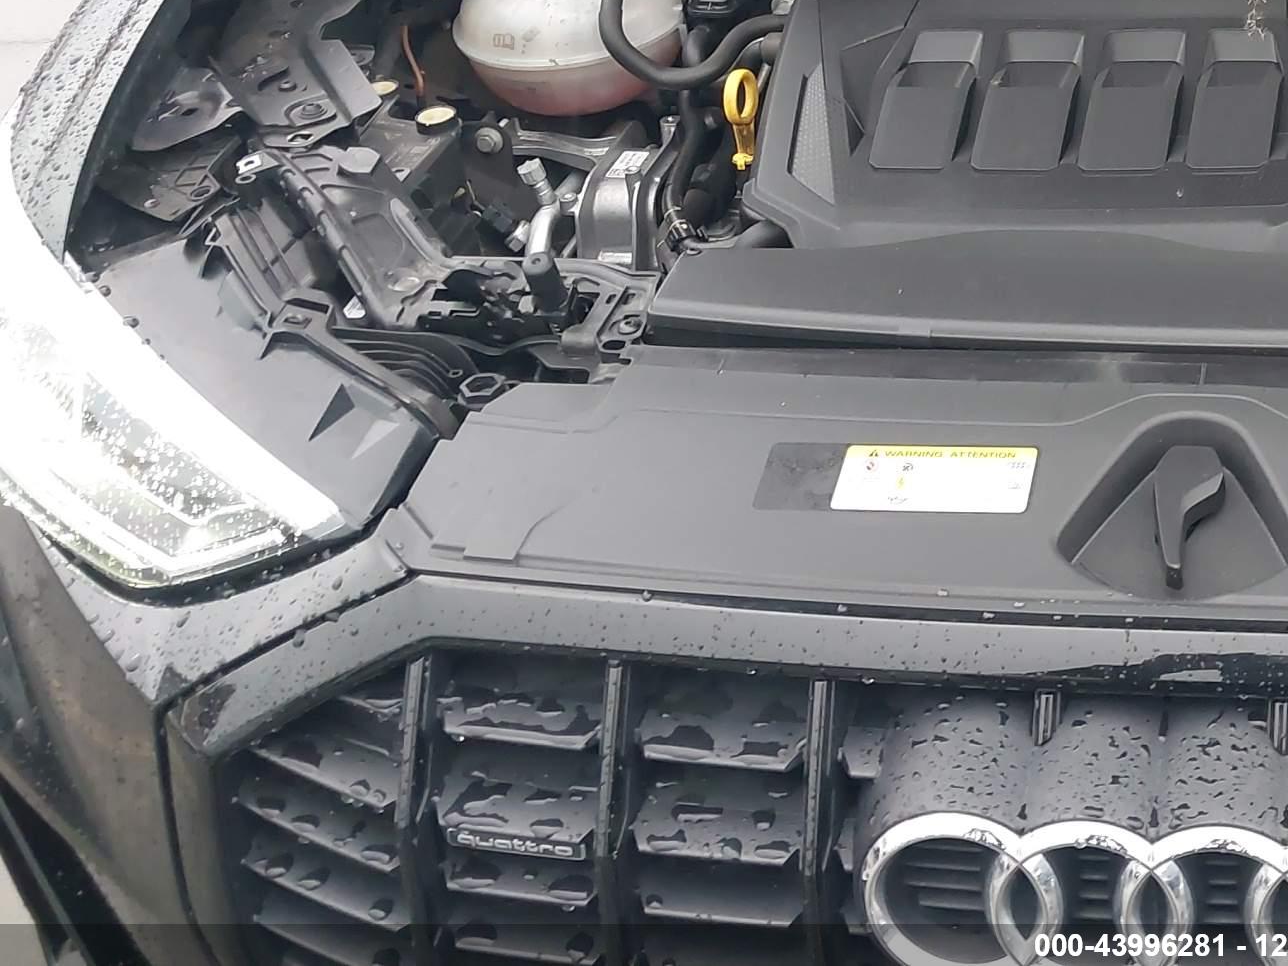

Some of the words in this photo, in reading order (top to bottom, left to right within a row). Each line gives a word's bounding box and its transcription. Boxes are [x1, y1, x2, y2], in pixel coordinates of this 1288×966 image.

[884, 450, 943, 458] WARNING
[950, 450, 1017, 459] ATTENTION
[456, 835, 574, 857] quattro
